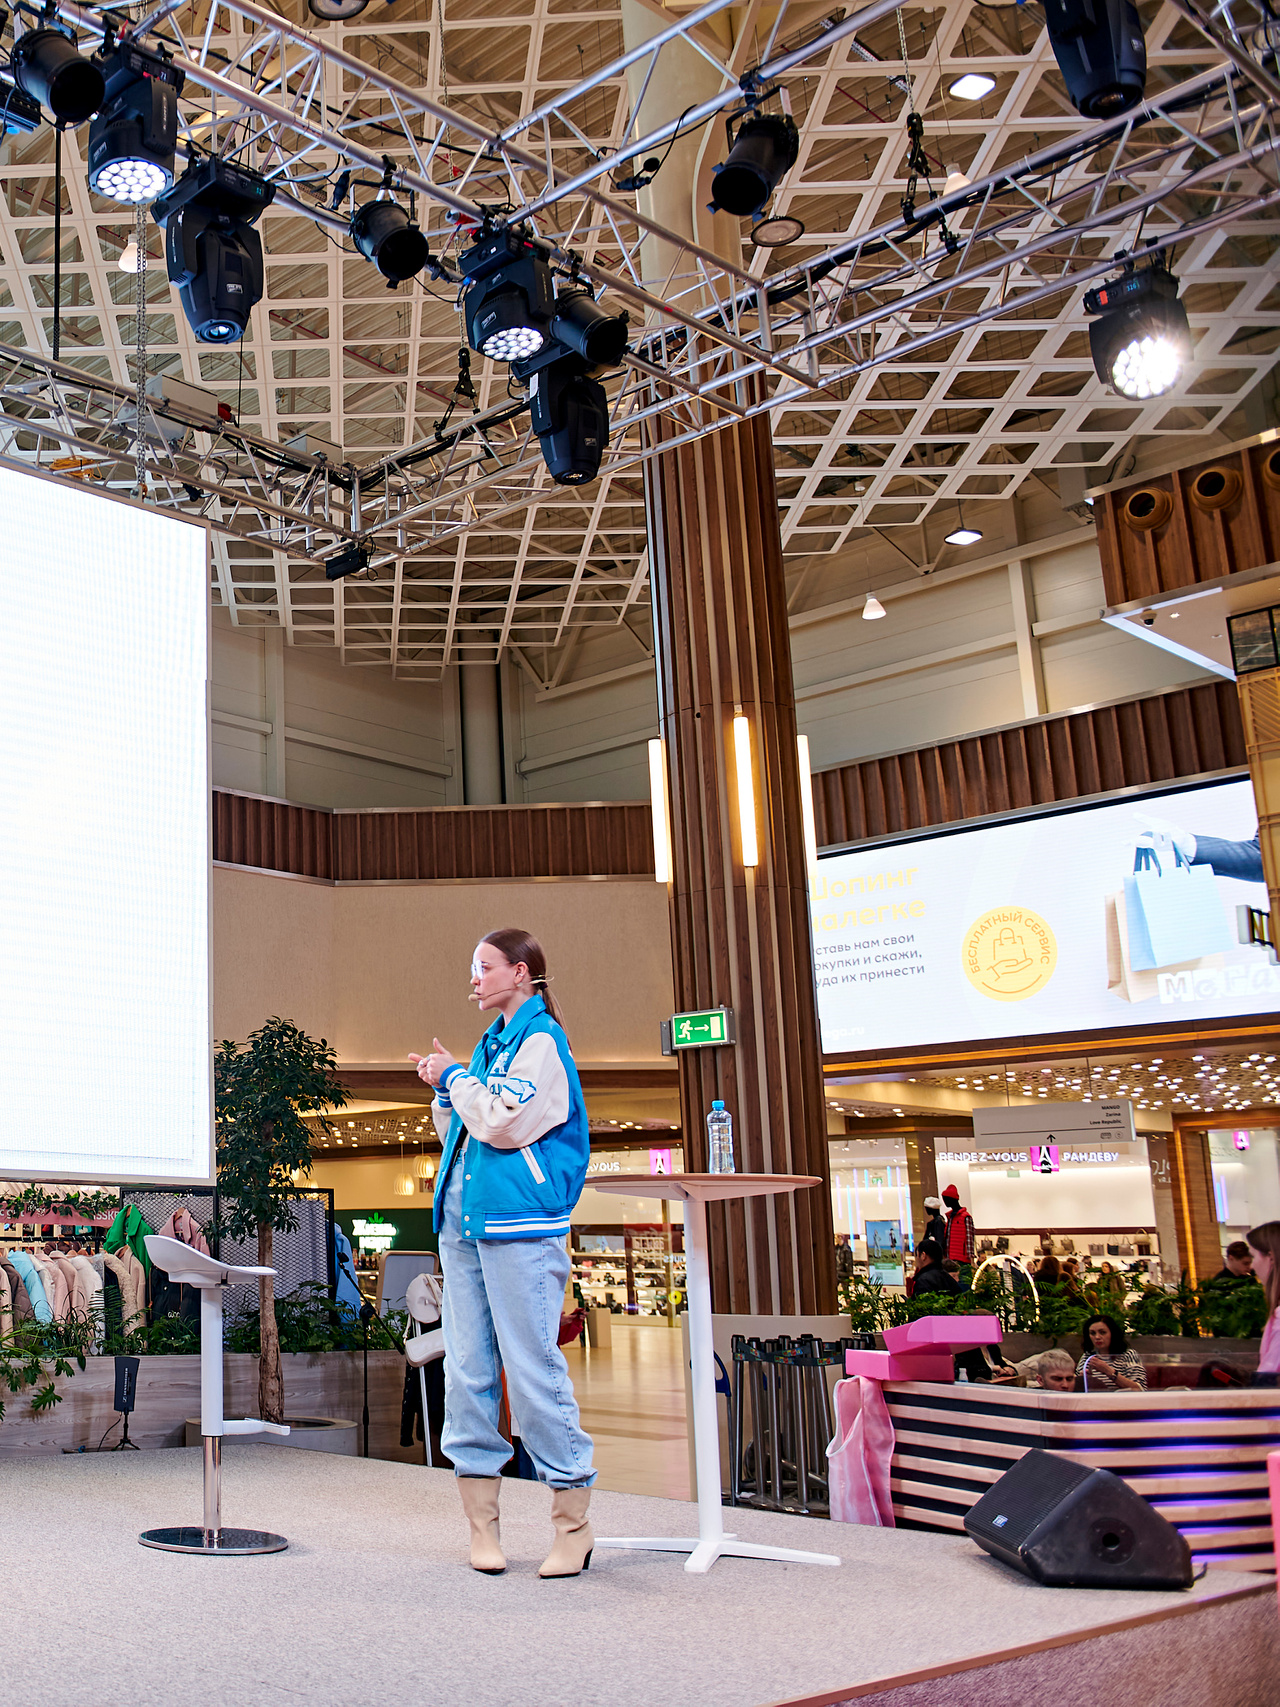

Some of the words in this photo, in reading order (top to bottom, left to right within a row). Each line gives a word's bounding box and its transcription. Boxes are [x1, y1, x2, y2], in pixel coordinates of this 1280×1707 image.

[815, 943, 852, 956] ставь
[853, 938, 881, 951] нам
[882, 933, 916, 947] свои
[967, 910, 1023, 974] БЕСПЛАТНЫЙ
[1024, 917, 1051, 965] СЕРВИС
[814, 956, 861, 972] окупки
[863, 954, 872, 965] и
[874, 949, 923, 964] скажи,
[816, 975, 839, 989] уда
[841, 972, 857, 984] их
[859, 964, 926, 983] принести
[823, 1026, 866, 1041] ega.ru
[937, 1152, 1029, 1163] RENDEZ-VOUS
[1062, 1152, 1119, 1163] РАНДЕВУ
